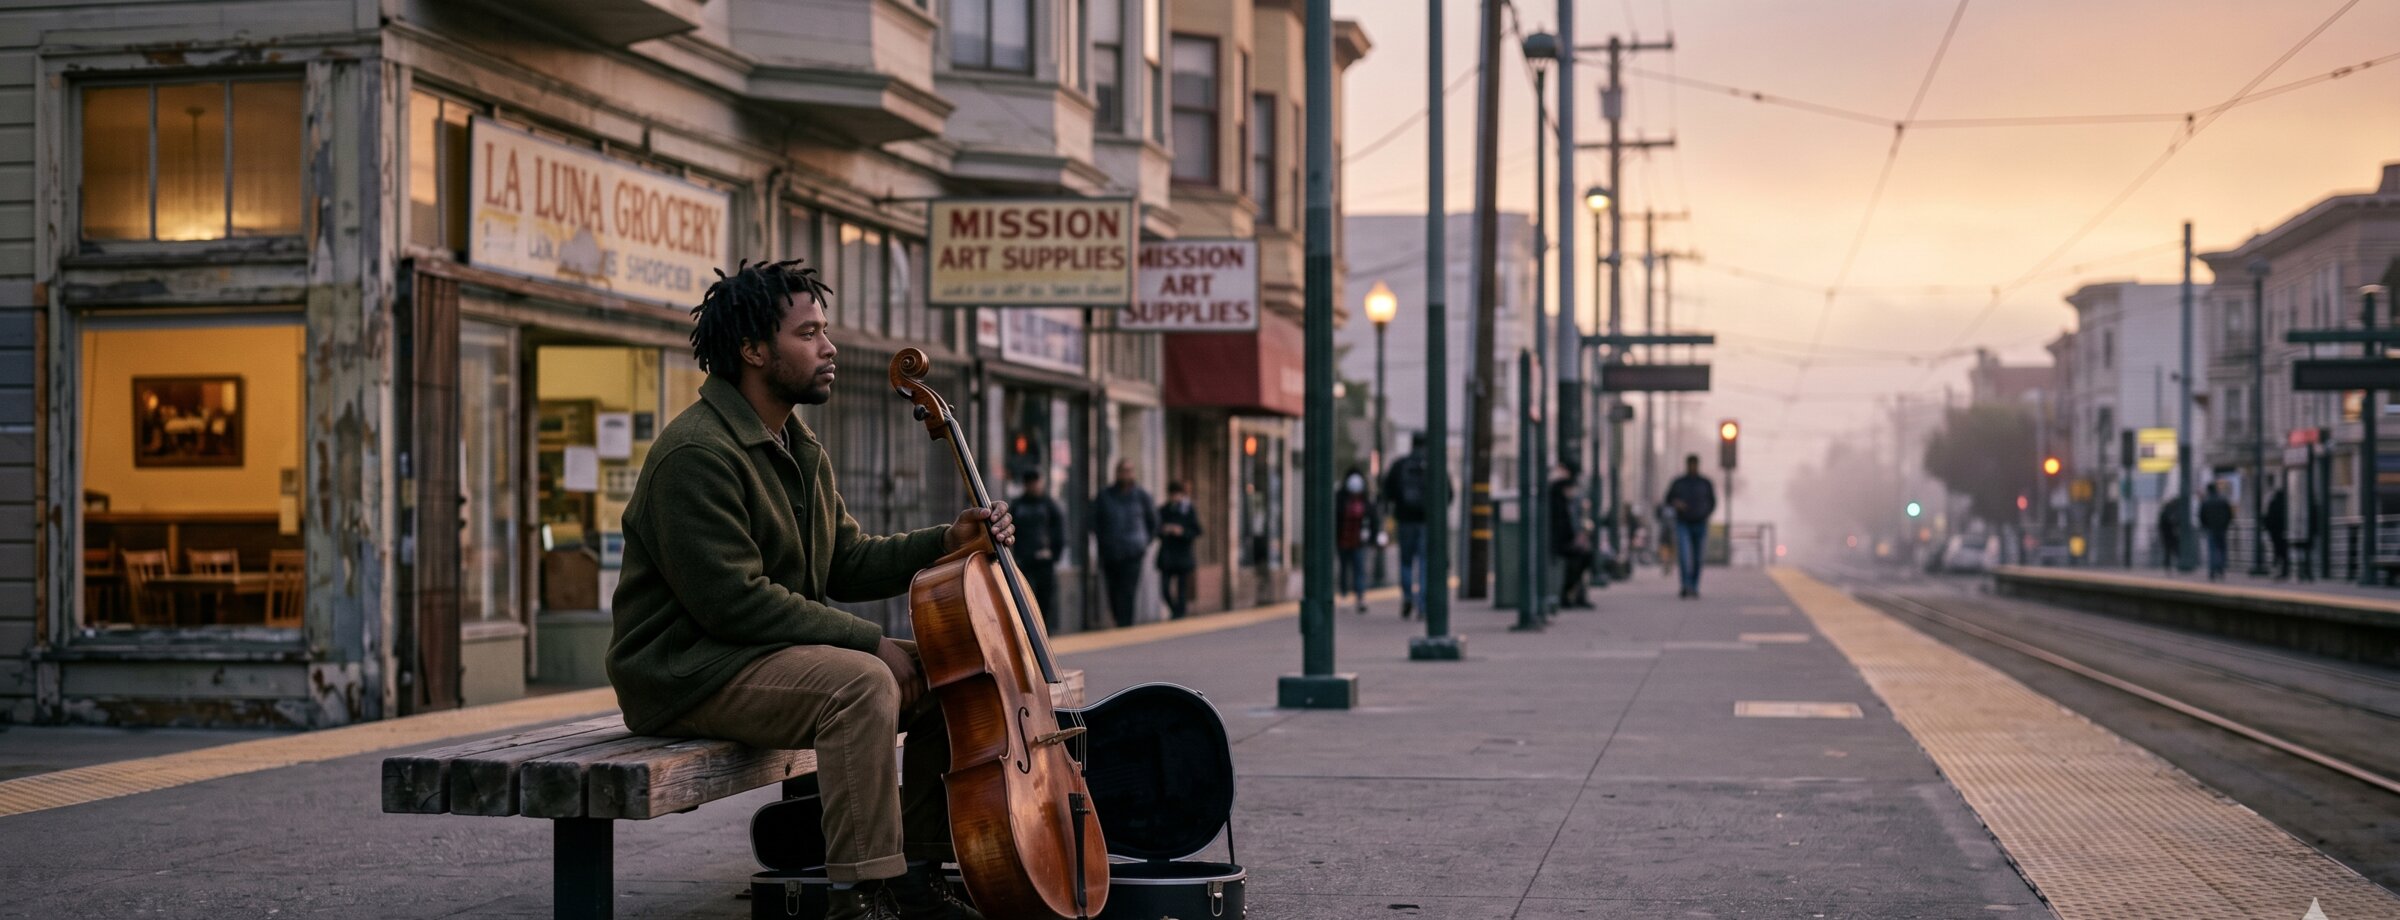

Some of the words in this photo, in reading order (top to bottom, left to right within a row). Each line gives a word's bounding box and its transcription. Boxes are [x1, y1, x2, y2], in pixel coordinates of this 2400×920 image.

[484, 142, 522, 213] LA
[535, 156, 604, 233] LUNA
[613, 179, 721, 259] GROCERY
[949, 208, 1121, 240] MISSION
[938, 245, 992, 272] ART
[1001, 245, 1126, 272] SUPPLIES
[1159, 273, 1215, 297] ART
[1121, 302, 1251, 324] SUPPLIES
